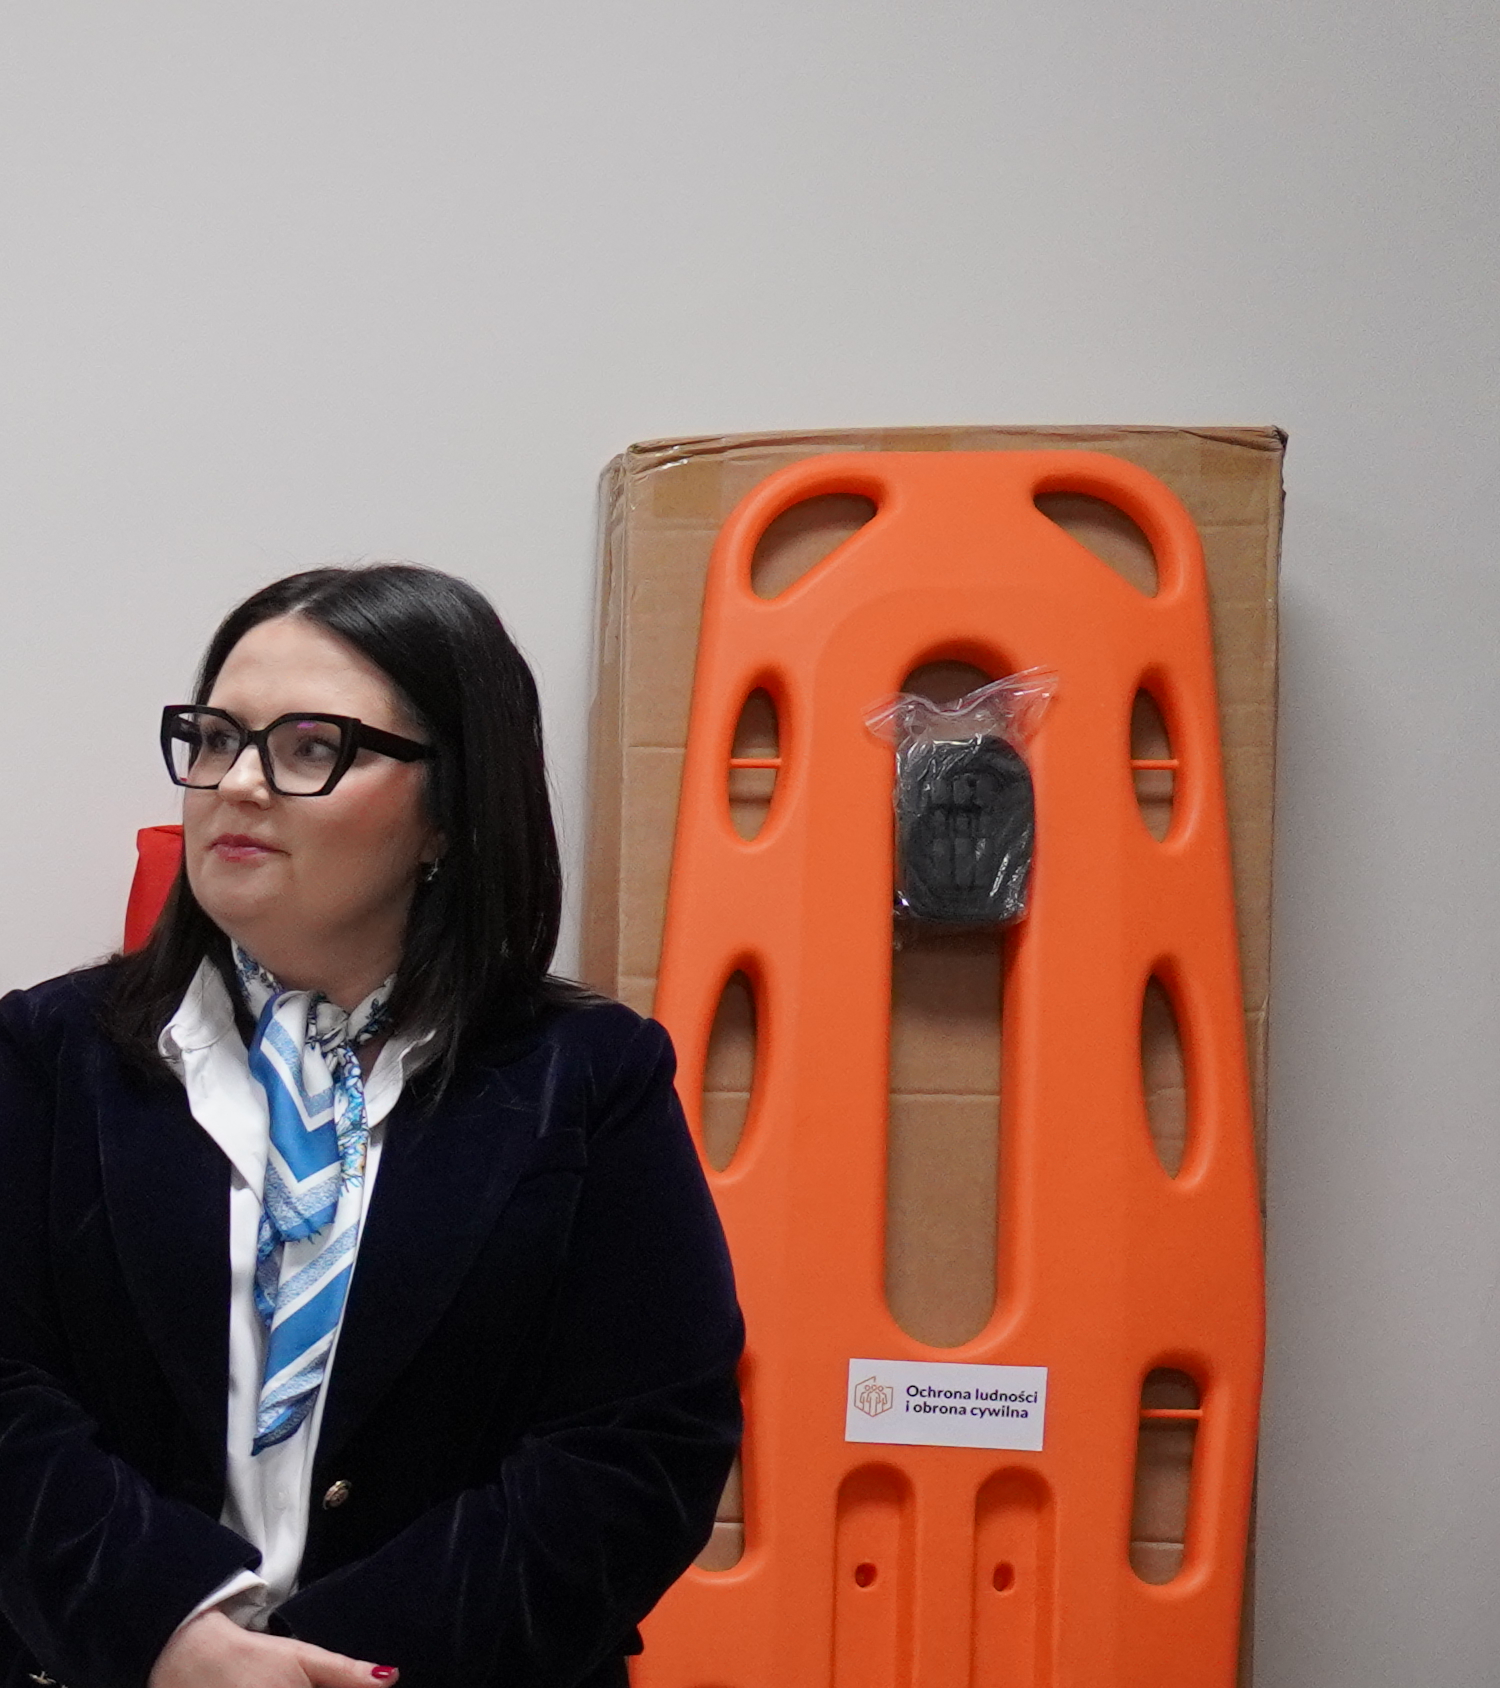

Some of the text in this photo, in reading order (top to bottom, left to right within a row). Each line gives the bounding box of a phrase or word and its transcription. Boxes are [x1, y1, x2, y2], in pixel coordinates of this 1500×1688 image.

[906, 1385, 1038, 1404] Ochrona ludności
[905, 1400, 1029, 1419] i obrona cywilna
